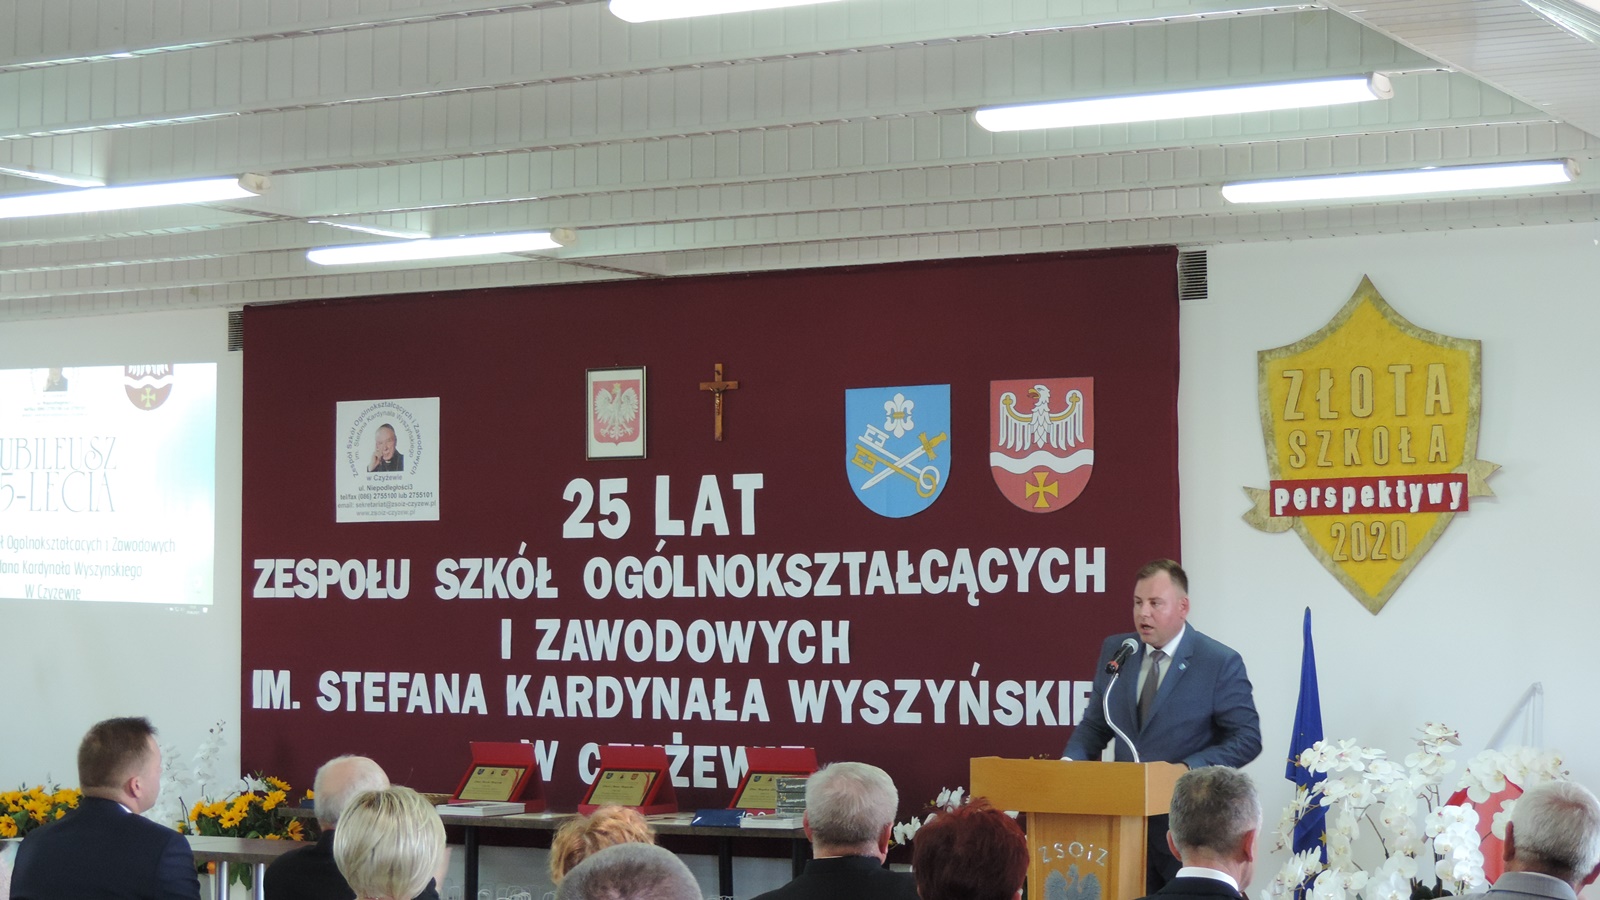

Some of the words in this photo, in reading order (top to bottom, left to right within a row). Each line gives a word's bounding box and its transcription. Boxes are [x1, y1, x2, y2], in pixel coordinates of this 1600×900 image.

[1282, 363, 1452, 421] ZŁOTA
[0, 436, 117, 470] UBILEUSZ
[410, 423, 422, 476] Zawodowych
[1288, 424, 1448, 469] SZKOŁA
[0, 470, 116, 513] 5-LECIA
[373, 474, 403, 482] Czyżewie
[373, 492, 397, 500] 2755100
[408, 491, 433, 499] 2755101
[1274, 480, 1463, 516] perspektywy
[563, 477, 630, 539] 25
[655, 473, 763, 536] LAT
[112, 537, 176, 556] Zawodowych
[1330, 520, 1409, 562] 2020
[25, 584, 35, 598] W
[253, 557, 410, 600] ZESPOŁU
[435, 541, 558, 600] SZKÓŁ
[583, 539, 1106, 606] OGÓLNOKSZTAŁCĄCYCH
[501, 618, 511, 660] I
[536, 618, 850, 664] ZAWODOWYCH
[253, 669, 300, 710] IM.
[317, 671, 488, 715] STEFANA
[507, 675, 770, 723] KARDYNAŁA
[788, 661, 1094, 727] WYSZYŃSKIE
[578, 731, 806, 789] CŻEW
[1038, 842, 1108, 866] ZSOiZ
